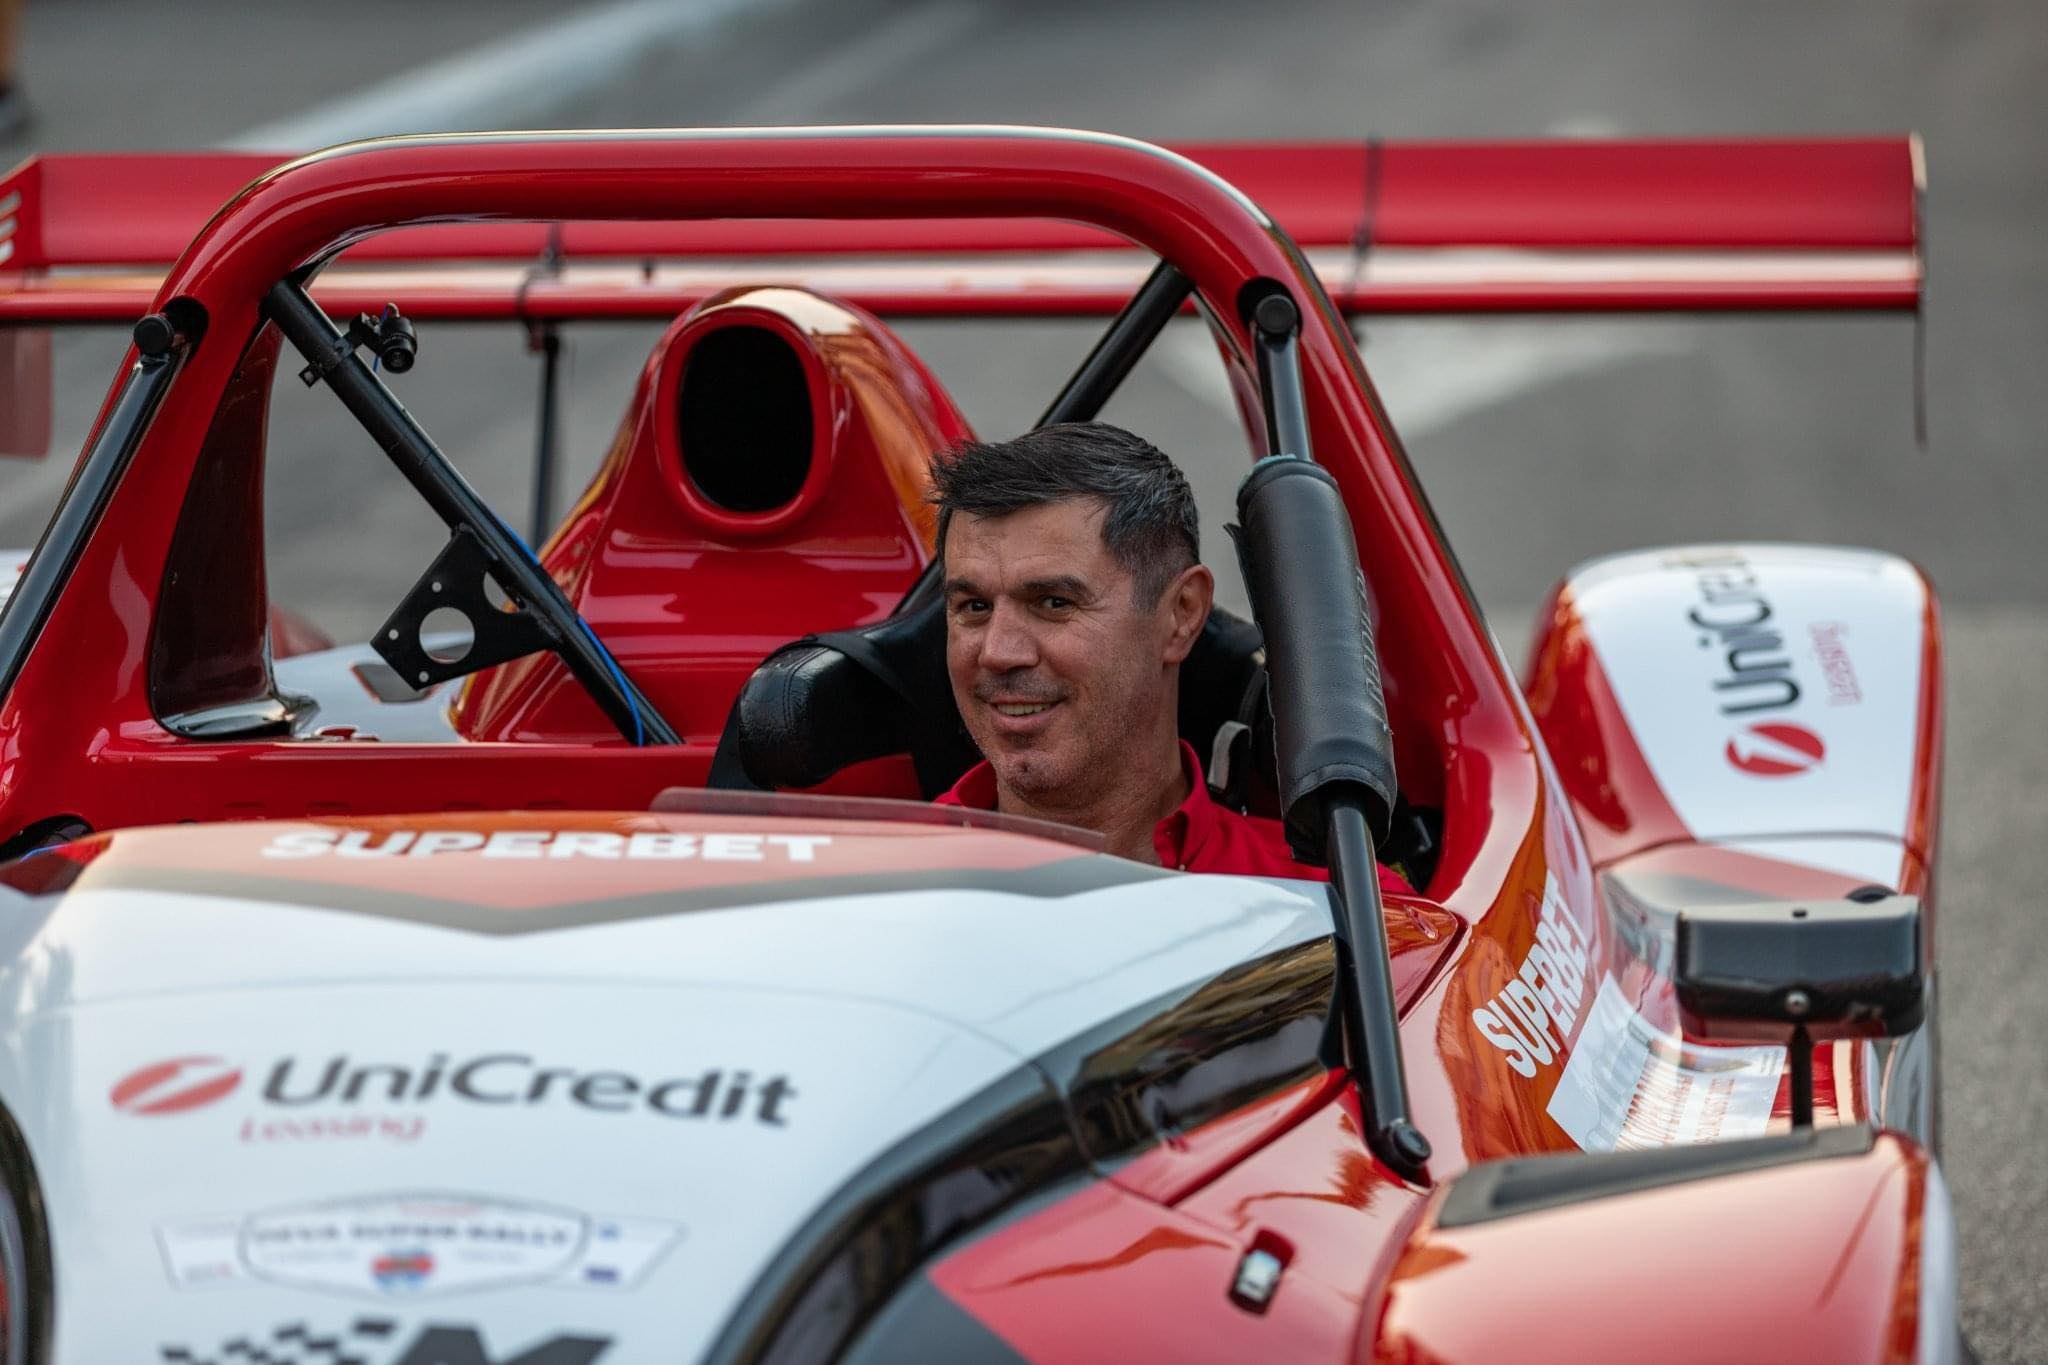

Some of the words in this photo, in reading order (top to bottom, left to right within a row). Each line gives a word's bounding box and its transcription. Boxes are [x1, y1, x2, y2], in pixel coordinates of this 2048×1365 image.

[261, 830, 832, 862] SUPERBET
[1472, 869, 1587, 1078] SUPERBET
[262, 1053, 799, 1129] UniCredit
